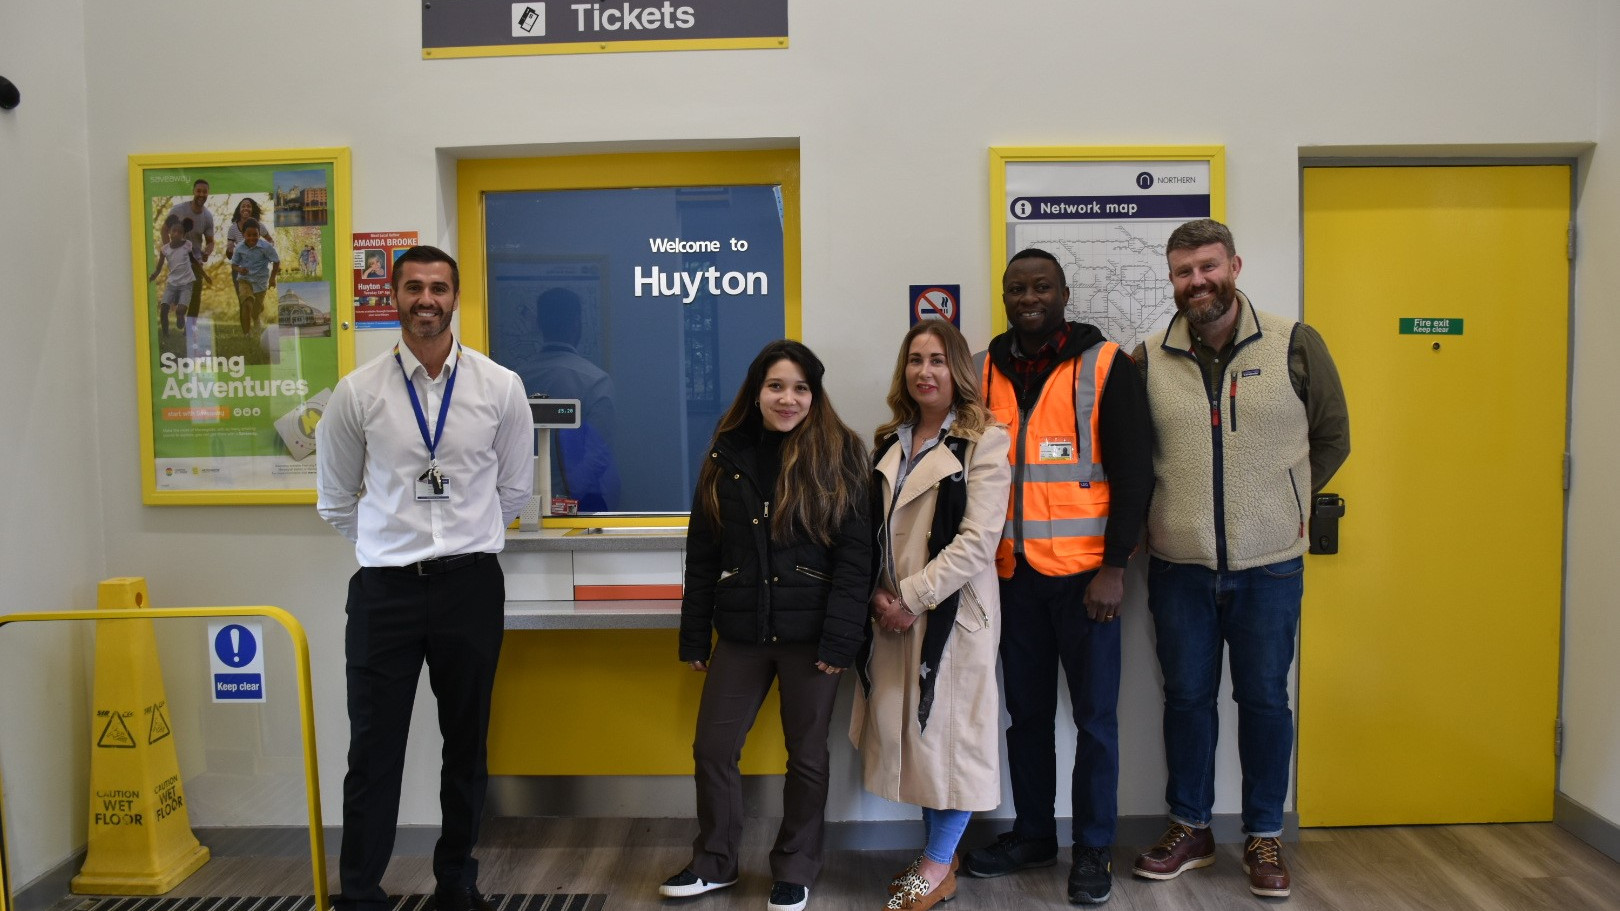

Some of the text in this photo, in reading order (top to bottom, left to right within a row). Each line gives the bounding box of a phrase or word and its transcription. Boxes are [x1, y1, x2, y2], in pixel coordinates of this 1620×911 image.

[571, 1, 695, 31] Tickets
[151, 175, 190, 183] saveaway
[1157, 176, 1196, 184] NORTHERN
[1040, 201, 1138, 216] Network map
[354, 237, 418, 247] AMANDA BROOKE
[649, 237, 748, 253] Welcome to
[358, 283, 380, 291] Huyton
[634, 266, 768, 304] Huyton
[160, 350, 245, 379] Spring
[161, 376, 309, 400] Adventures
[217, 682, 260, 692] Keep clear
[154, 775, 178, 795] CAUTION
[96, 790, 140, 799] CAUTION
[160, 786, 176, 805] WET
[103, 799, 134, 812] WET
[156, 796, 183, 821] FLOOR
[95, 813, 143, 826] FLOOR
